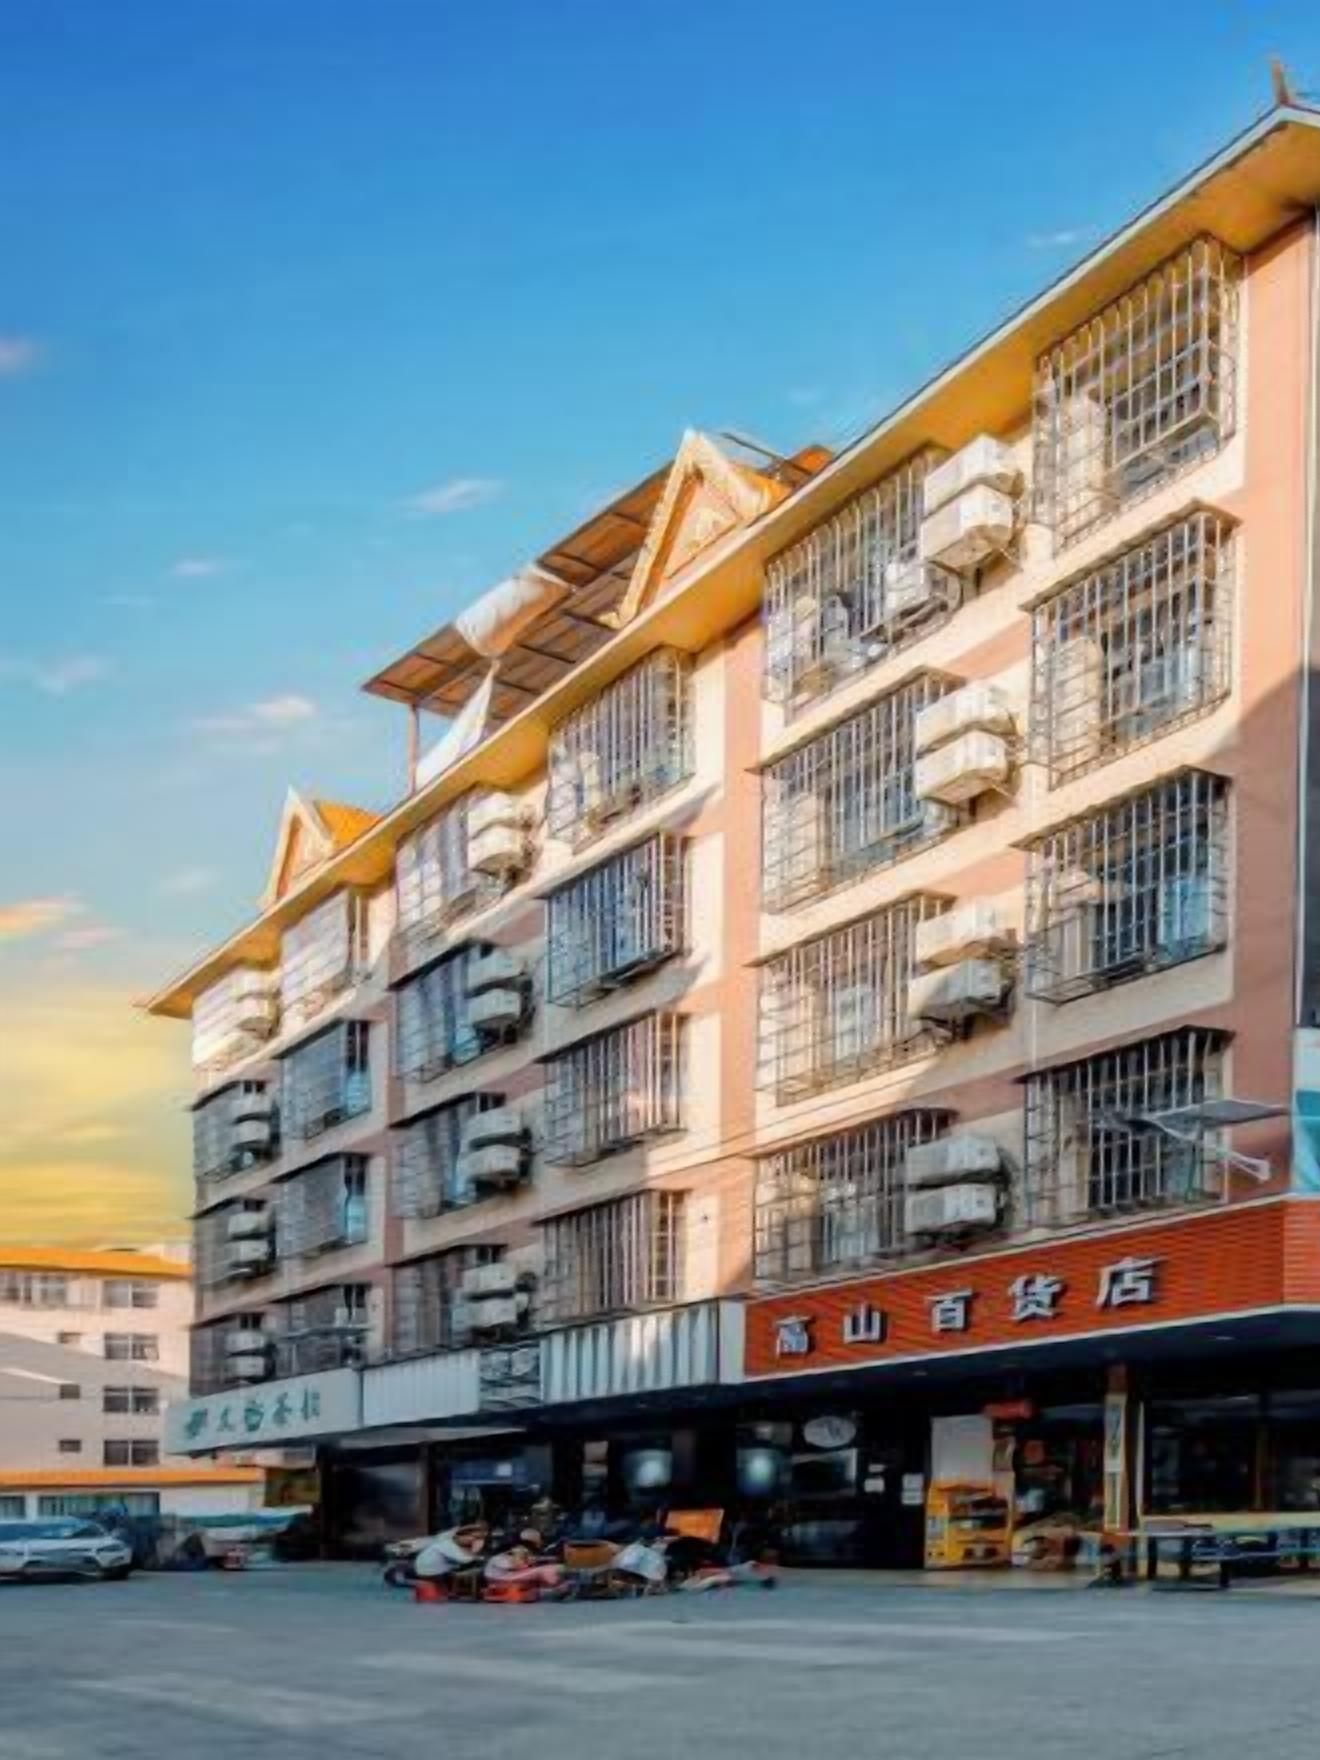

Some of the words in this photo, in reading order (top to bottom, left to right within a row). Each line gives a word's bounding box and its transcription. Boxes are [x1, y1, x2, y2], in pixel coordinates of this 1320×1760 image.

[774, 1256, 1164, 1358] 高山百货店
